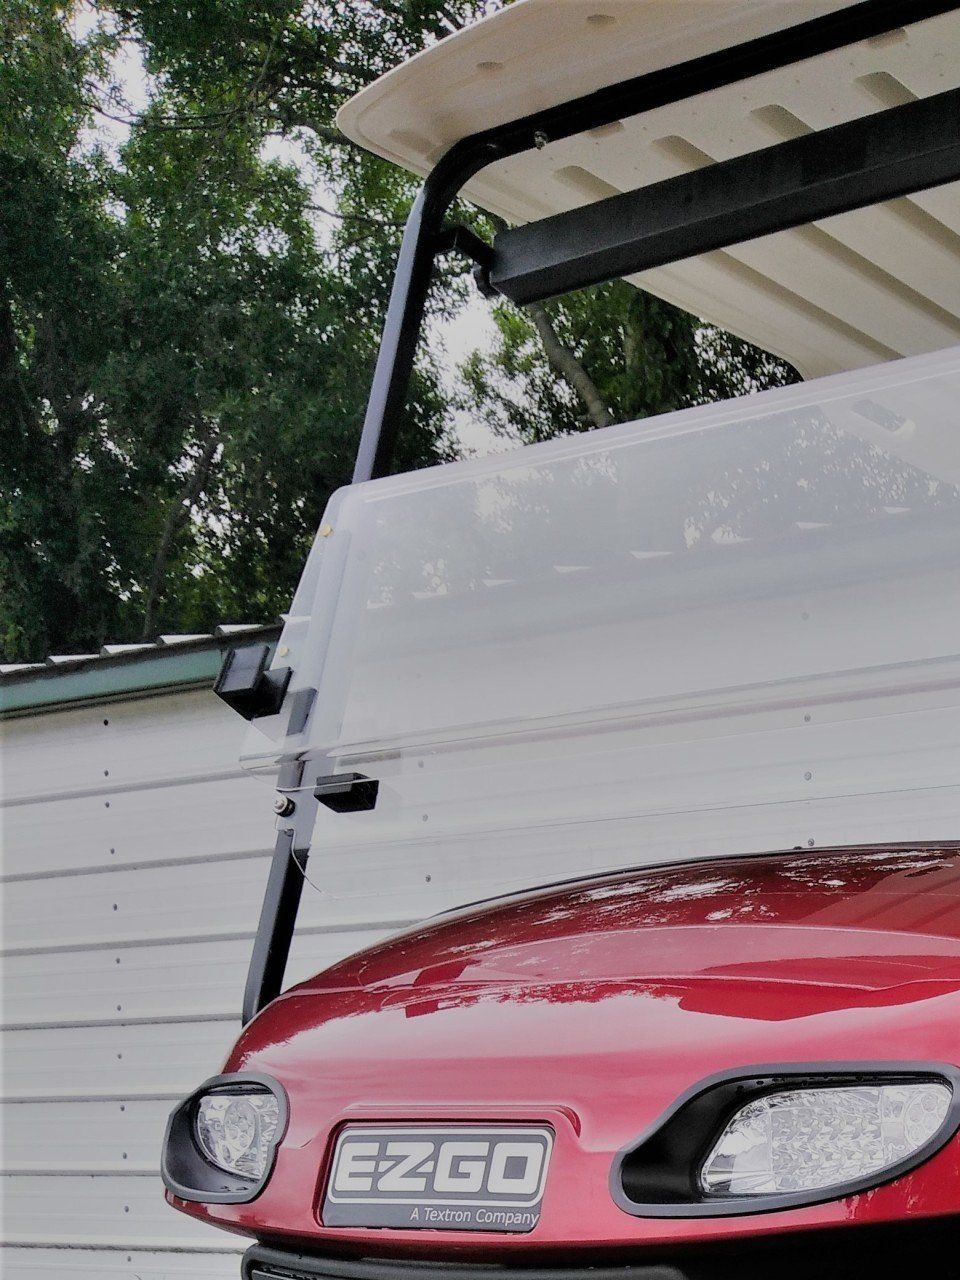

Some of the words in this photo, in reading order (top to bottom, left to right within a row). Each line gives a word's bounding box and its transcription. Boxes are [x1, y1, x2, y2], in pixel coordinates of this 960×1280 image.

[409, 1207, 419, 1221] A
[423, 1207, 472, 1223] Textron
[475, 1208, 540, 1227] Company
